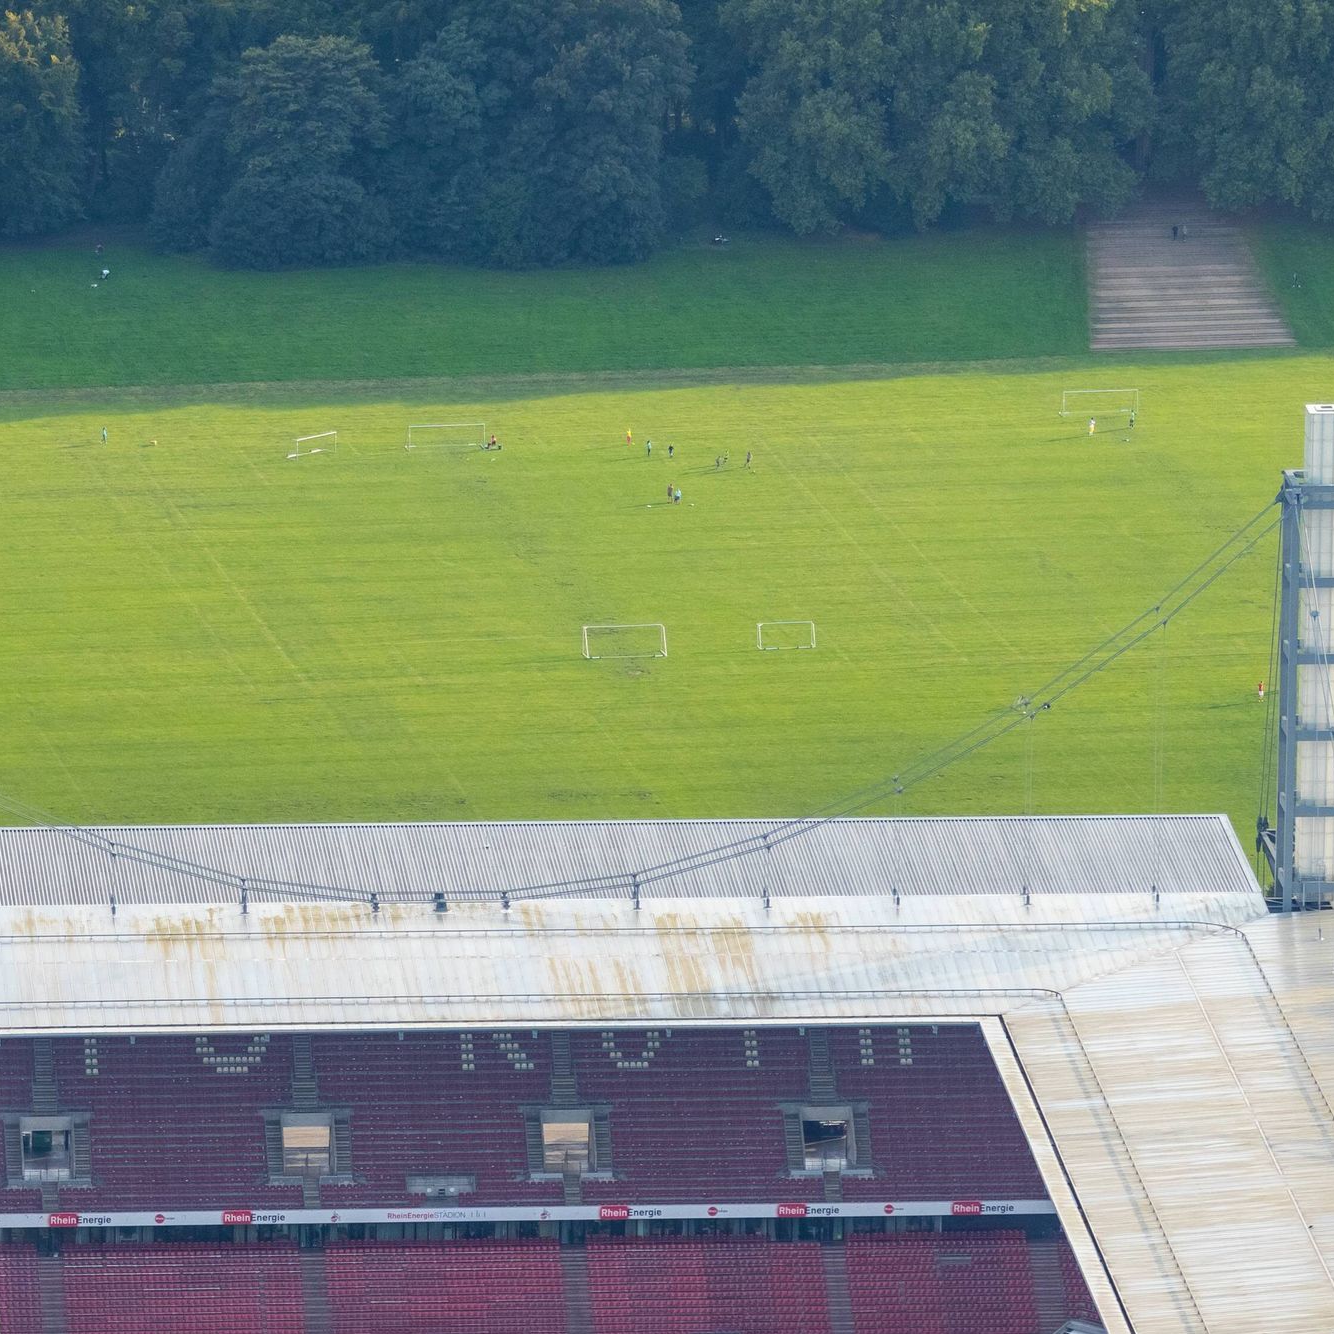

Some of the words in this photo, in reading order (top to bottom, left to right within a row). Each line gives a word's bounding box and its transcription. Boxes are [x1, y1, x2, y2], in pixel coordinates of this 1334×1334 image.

[601, 1208, 662, 1218] RheinEnergie
[779, 1206, 840, 1216] RheinEnergie
[953, 1203, 1015, 1214] RheinEnergie
[50, 1215, 112, 1226] RheinEnergie
[224, 1213, 286, 1223] RheinEnergie
[387, 1211, 466, 1221] RheinEnergieSTADION
